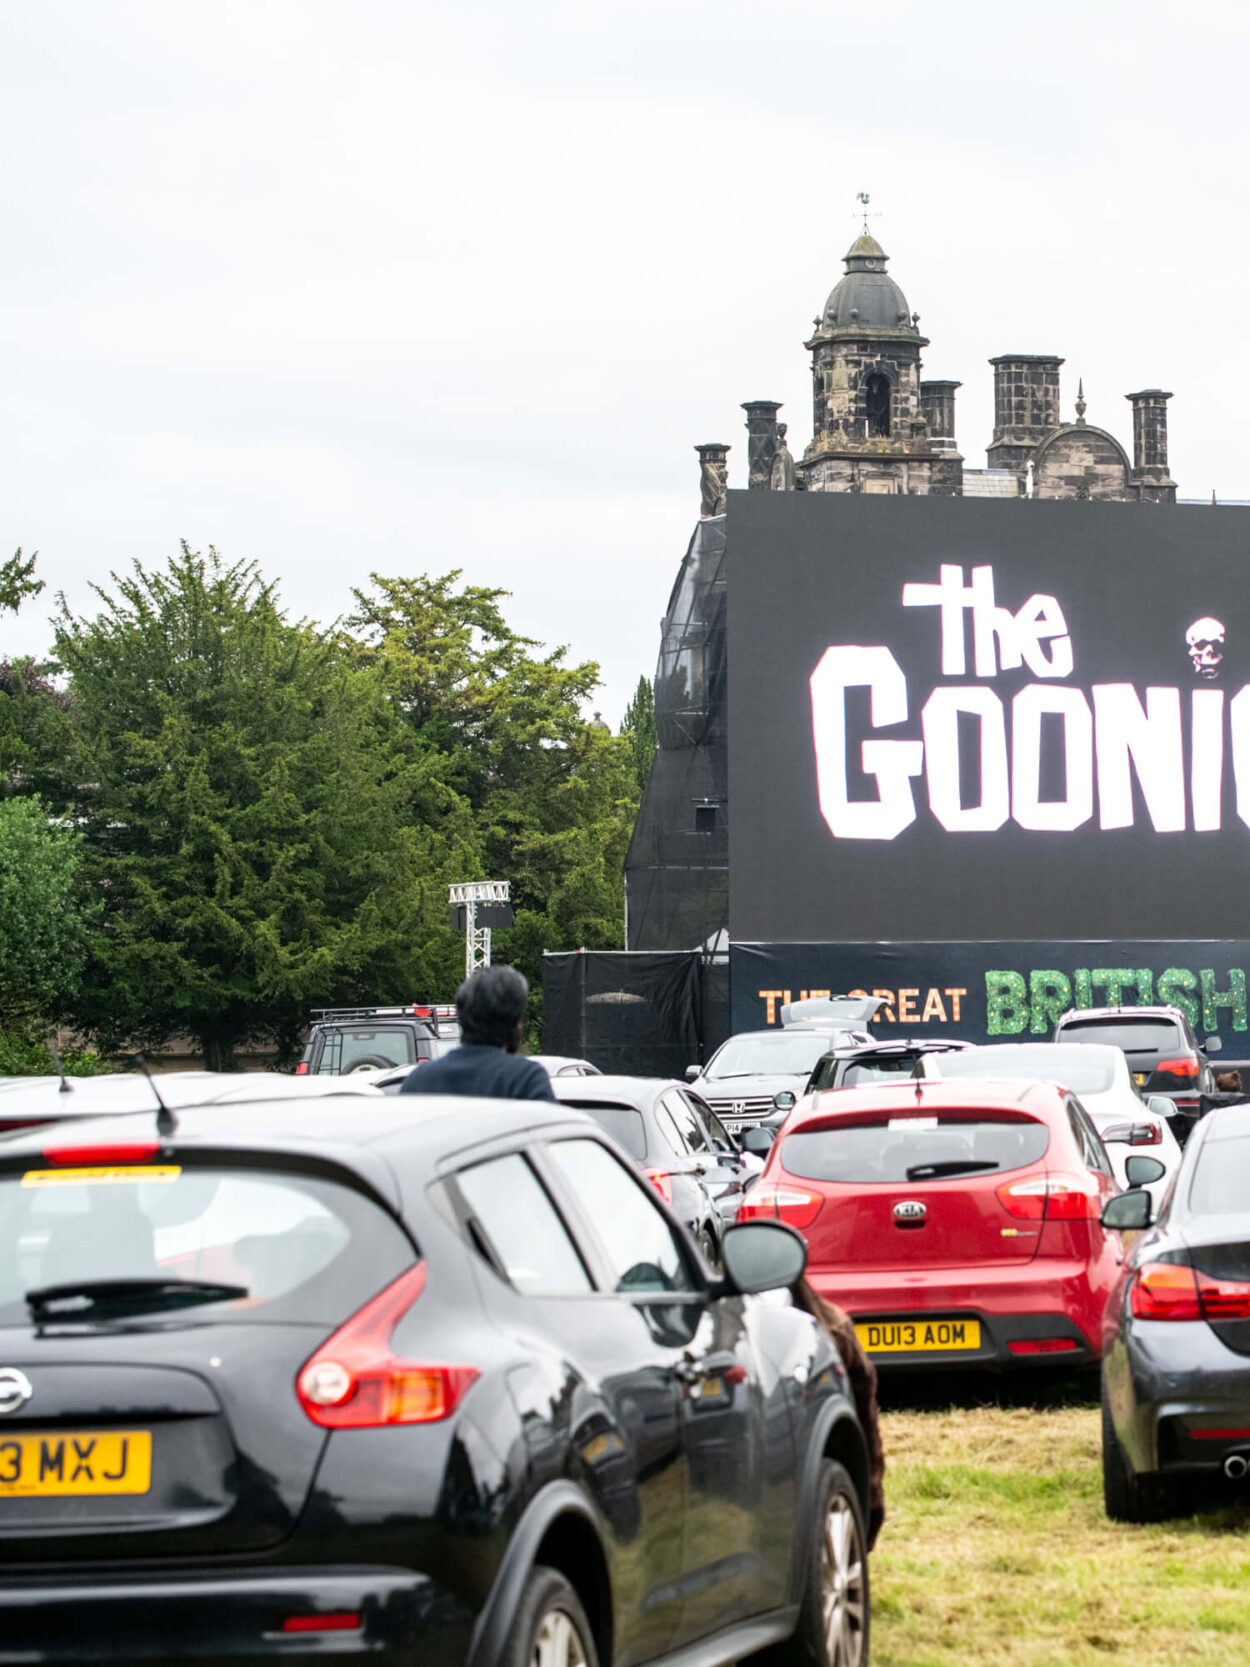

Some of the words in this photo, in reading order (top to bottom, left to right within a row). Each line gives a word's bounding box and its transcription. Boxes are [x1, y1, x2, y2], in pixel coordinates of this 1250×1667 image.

[848, 988, 967, 1023] REAT
[867, 1325, 916, 1347] DU13
[924, 1323, 966, 1345] AOM
[39, 1439, 128, 1482] MXJ
